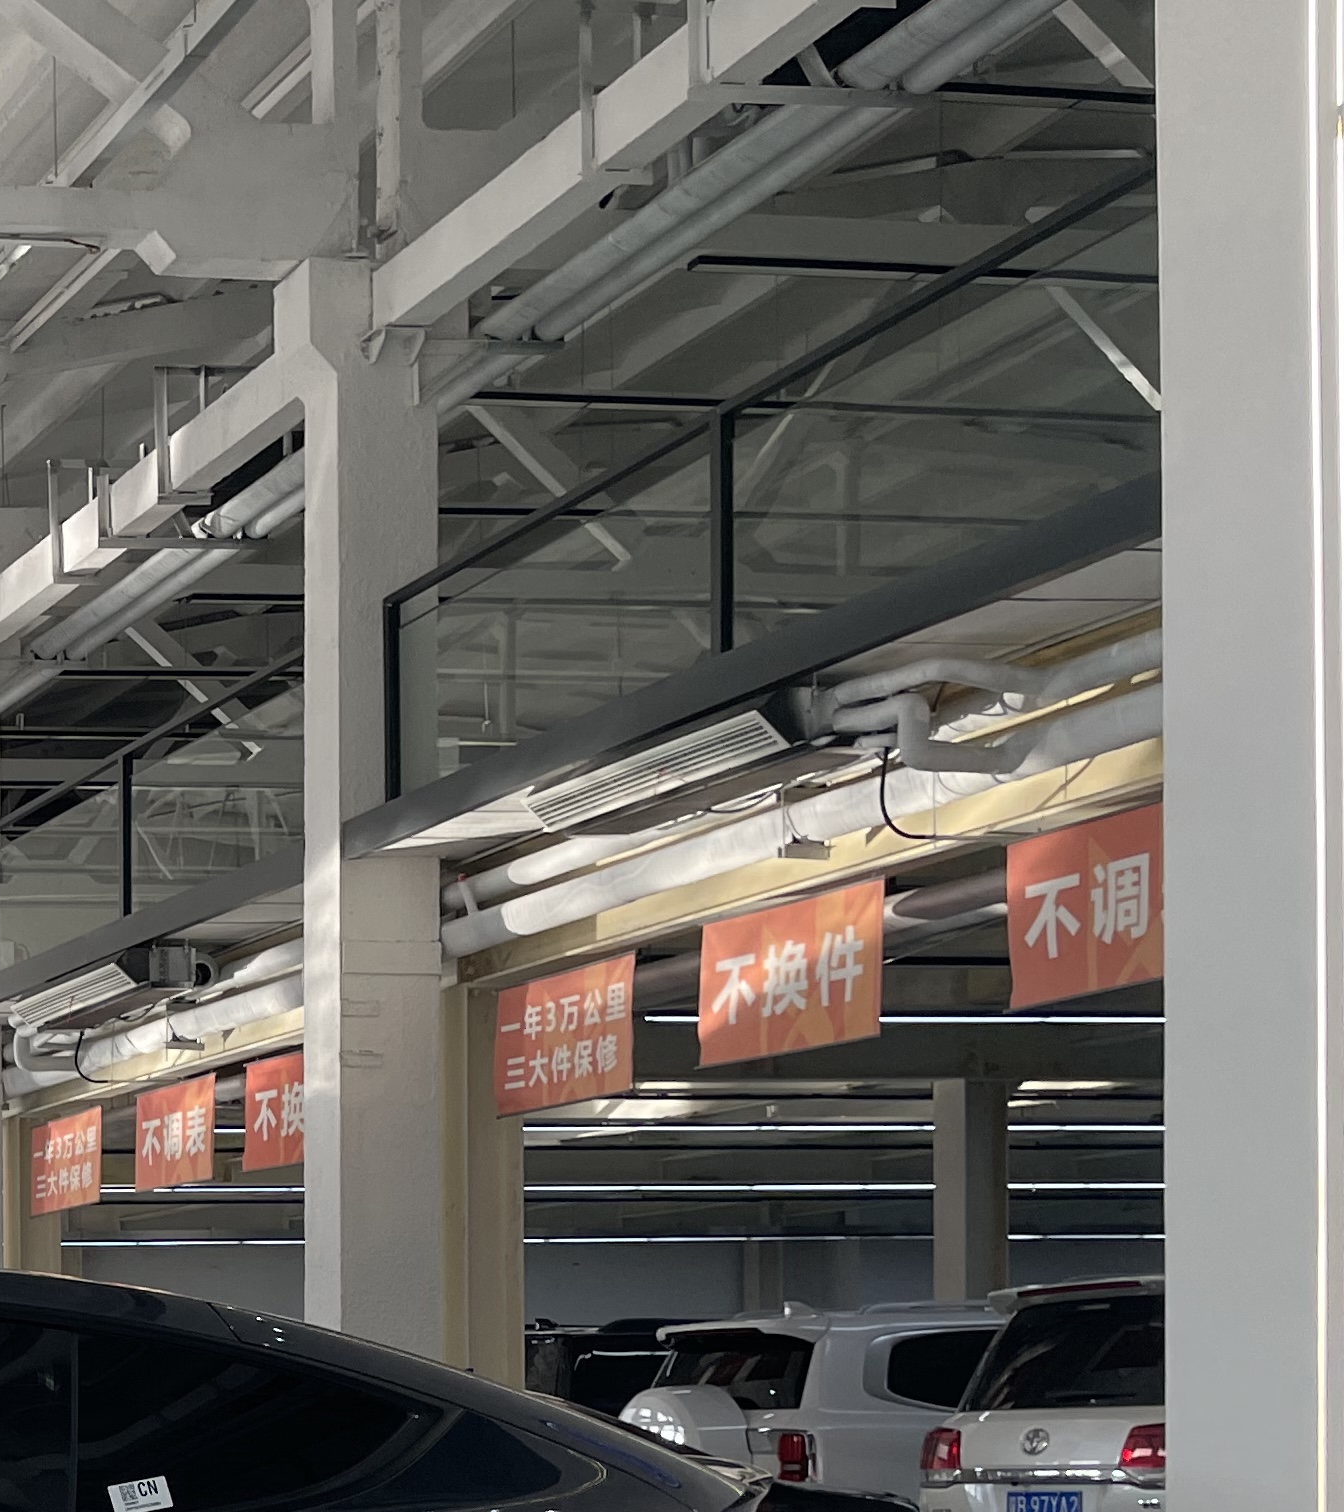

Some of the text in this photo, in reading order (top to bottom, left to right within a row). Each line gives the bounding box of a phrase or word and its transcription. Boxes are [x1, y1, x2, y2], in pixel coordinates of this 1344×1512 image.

[1024, 853, 1164, 960] 不调
[712, 925, 864, 1025] 不换件
[501, 981, 626, 1040] 一年3万公里
[504, 1034, 618, 1090] 三大件保修
[33, 1125, 98, 1165] 一年3万公里
[141, 1105, 207, 1166] 不调表
[35, 1162, 93, 1199] 三大件保修
[137, 1480, 158, 1497] CN
